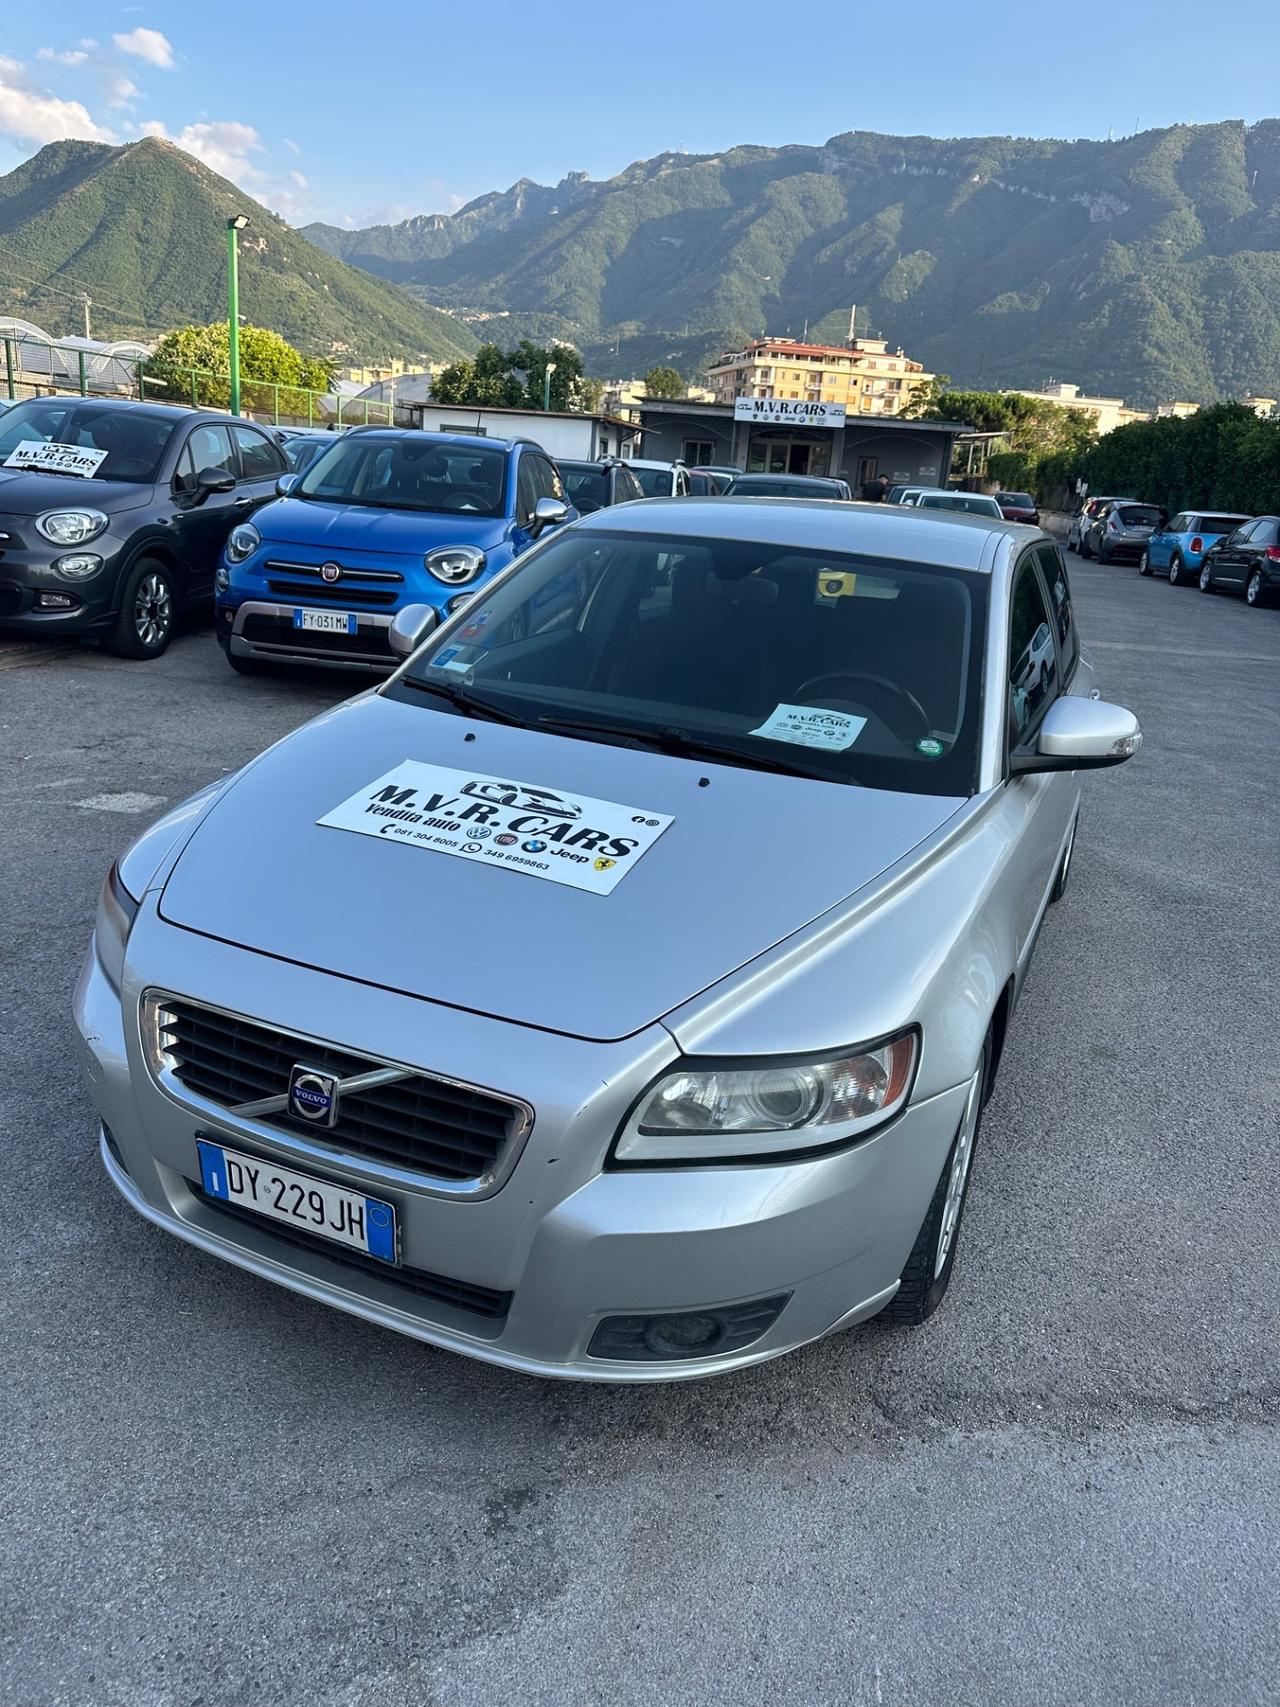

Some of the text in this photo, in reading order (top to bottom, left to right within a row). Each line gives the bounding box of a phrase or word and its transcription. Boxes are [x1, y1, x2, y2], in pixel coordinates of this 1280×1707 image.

[365, 803, 462, 832] Vendita auto
[394, 828, 459, 848] 081 304 8005
[484, 849, 551, 871] 349 6959863
[550, 848, 590, 864] Jeep
[295, 1089, 327, 1104] VOLVO
